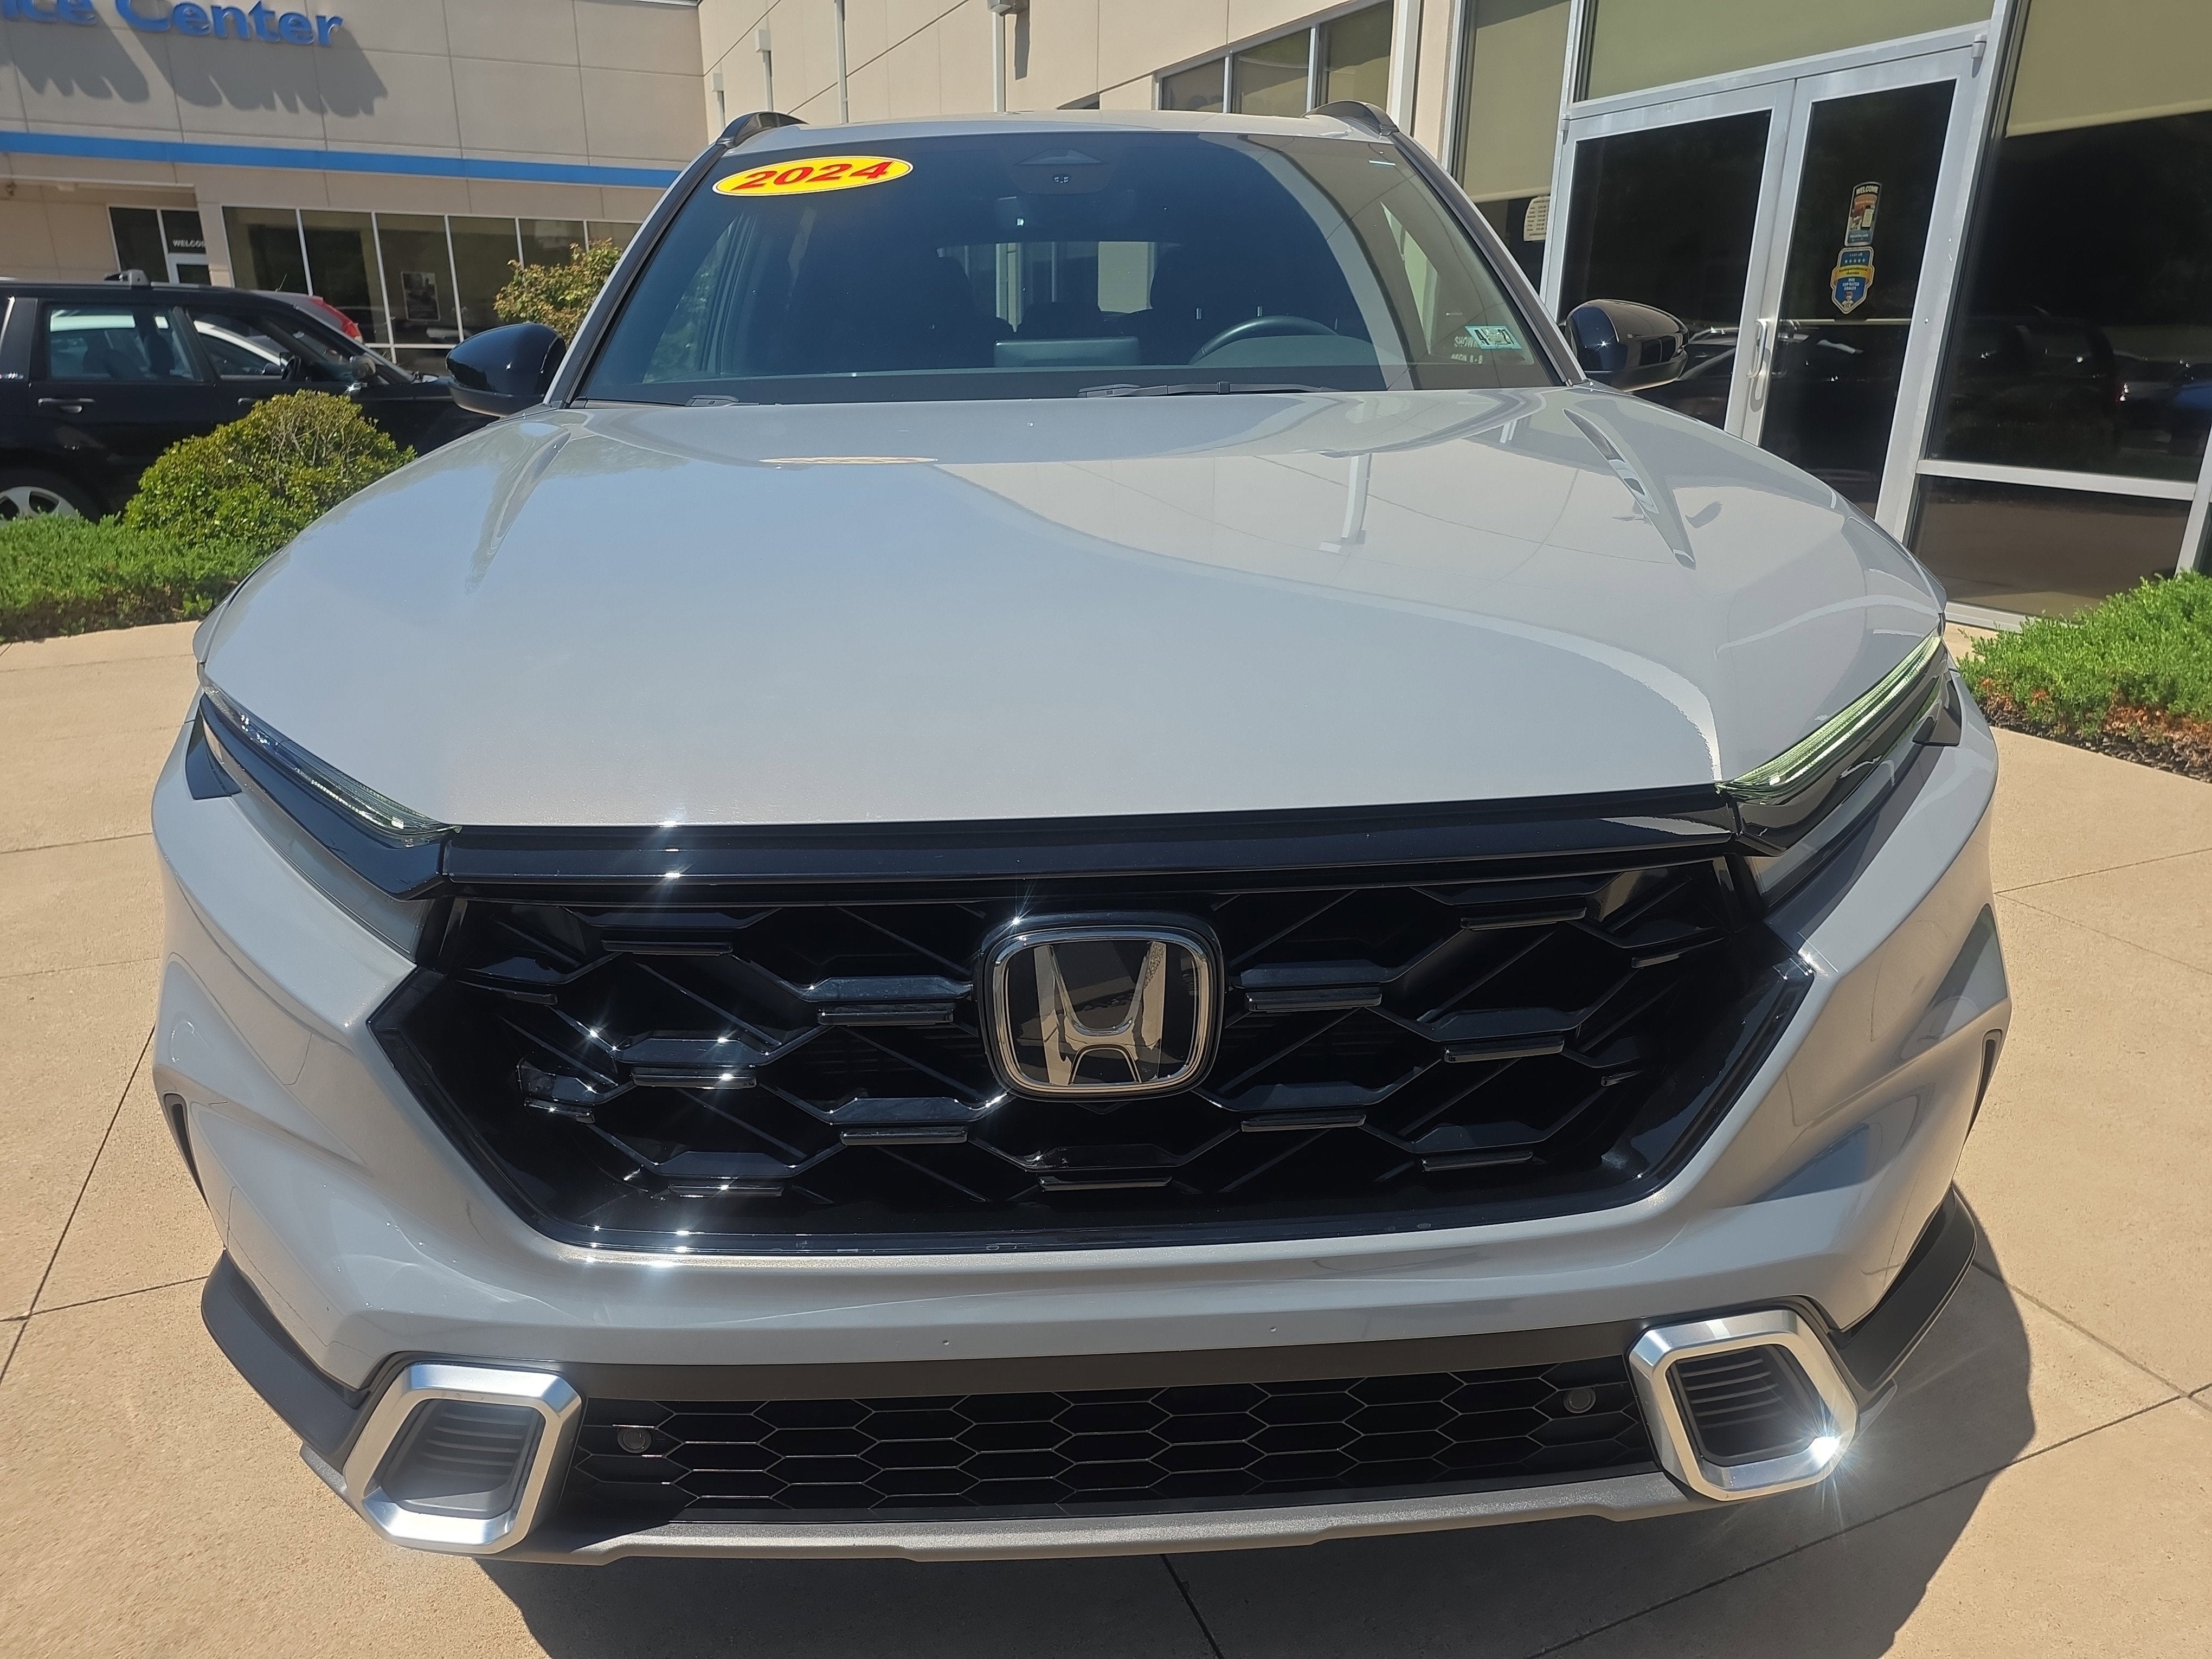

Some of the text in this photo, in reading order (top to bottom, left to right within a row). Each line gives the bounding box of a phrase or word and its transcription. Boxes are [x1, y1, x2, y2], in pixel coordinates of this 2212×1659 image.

[116, 0, 344, 47] Center
[730, 160, 895, 191] 2024
[1856, 185, 1879, 195] WELCOME
